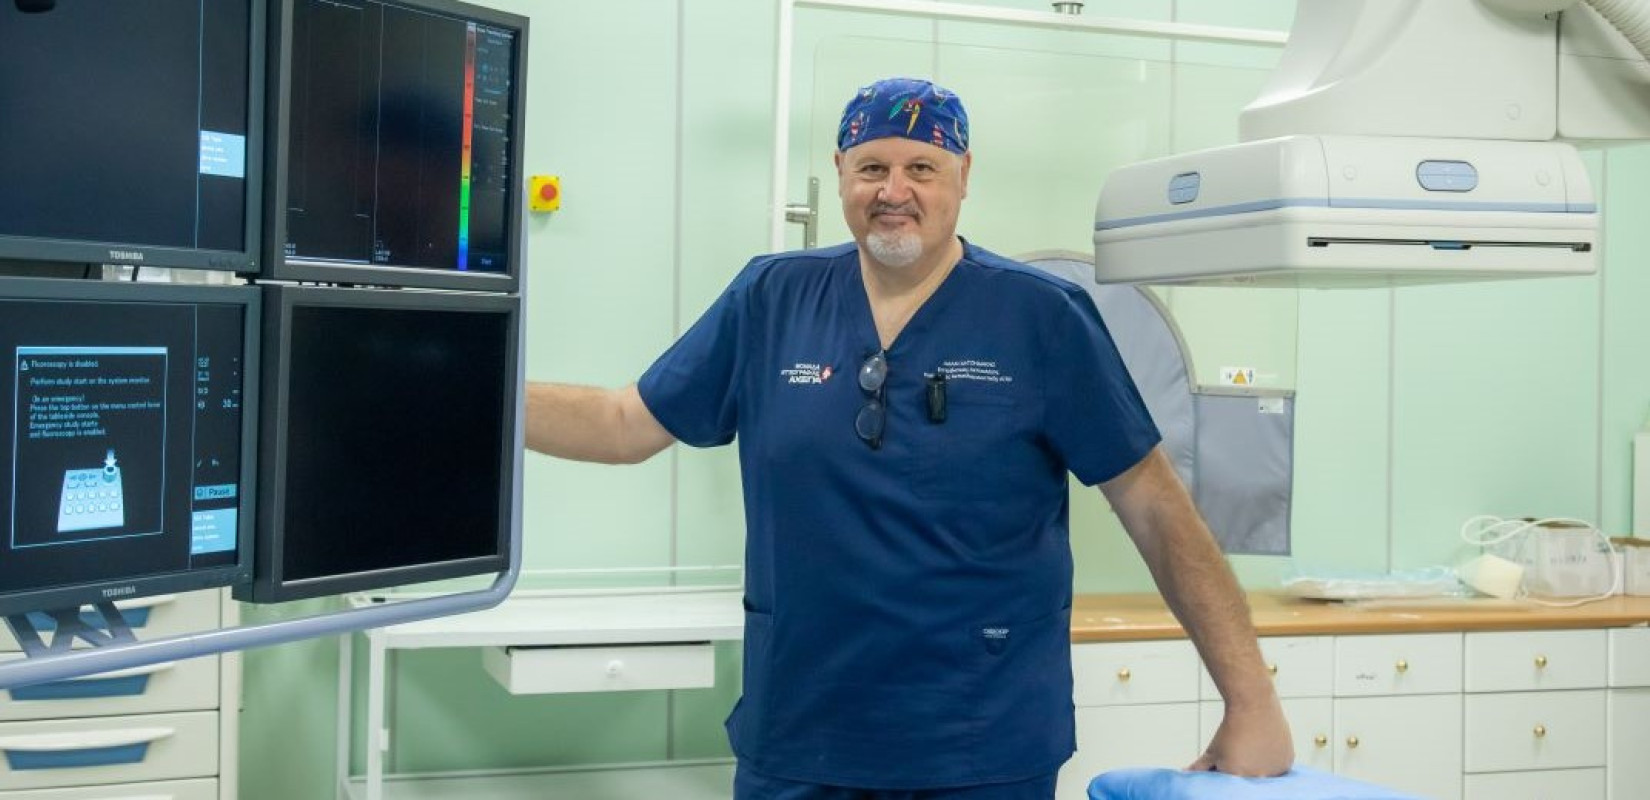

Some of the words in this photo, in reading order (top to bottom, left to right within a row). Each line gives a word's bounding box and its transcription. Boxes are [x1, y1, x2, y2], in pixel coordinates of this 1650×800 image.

[110, 250, 143, 260] TOSHIBA
[208, 488, 230, 497] Pause
[102, 585, 136, 598] TOSHIBA
